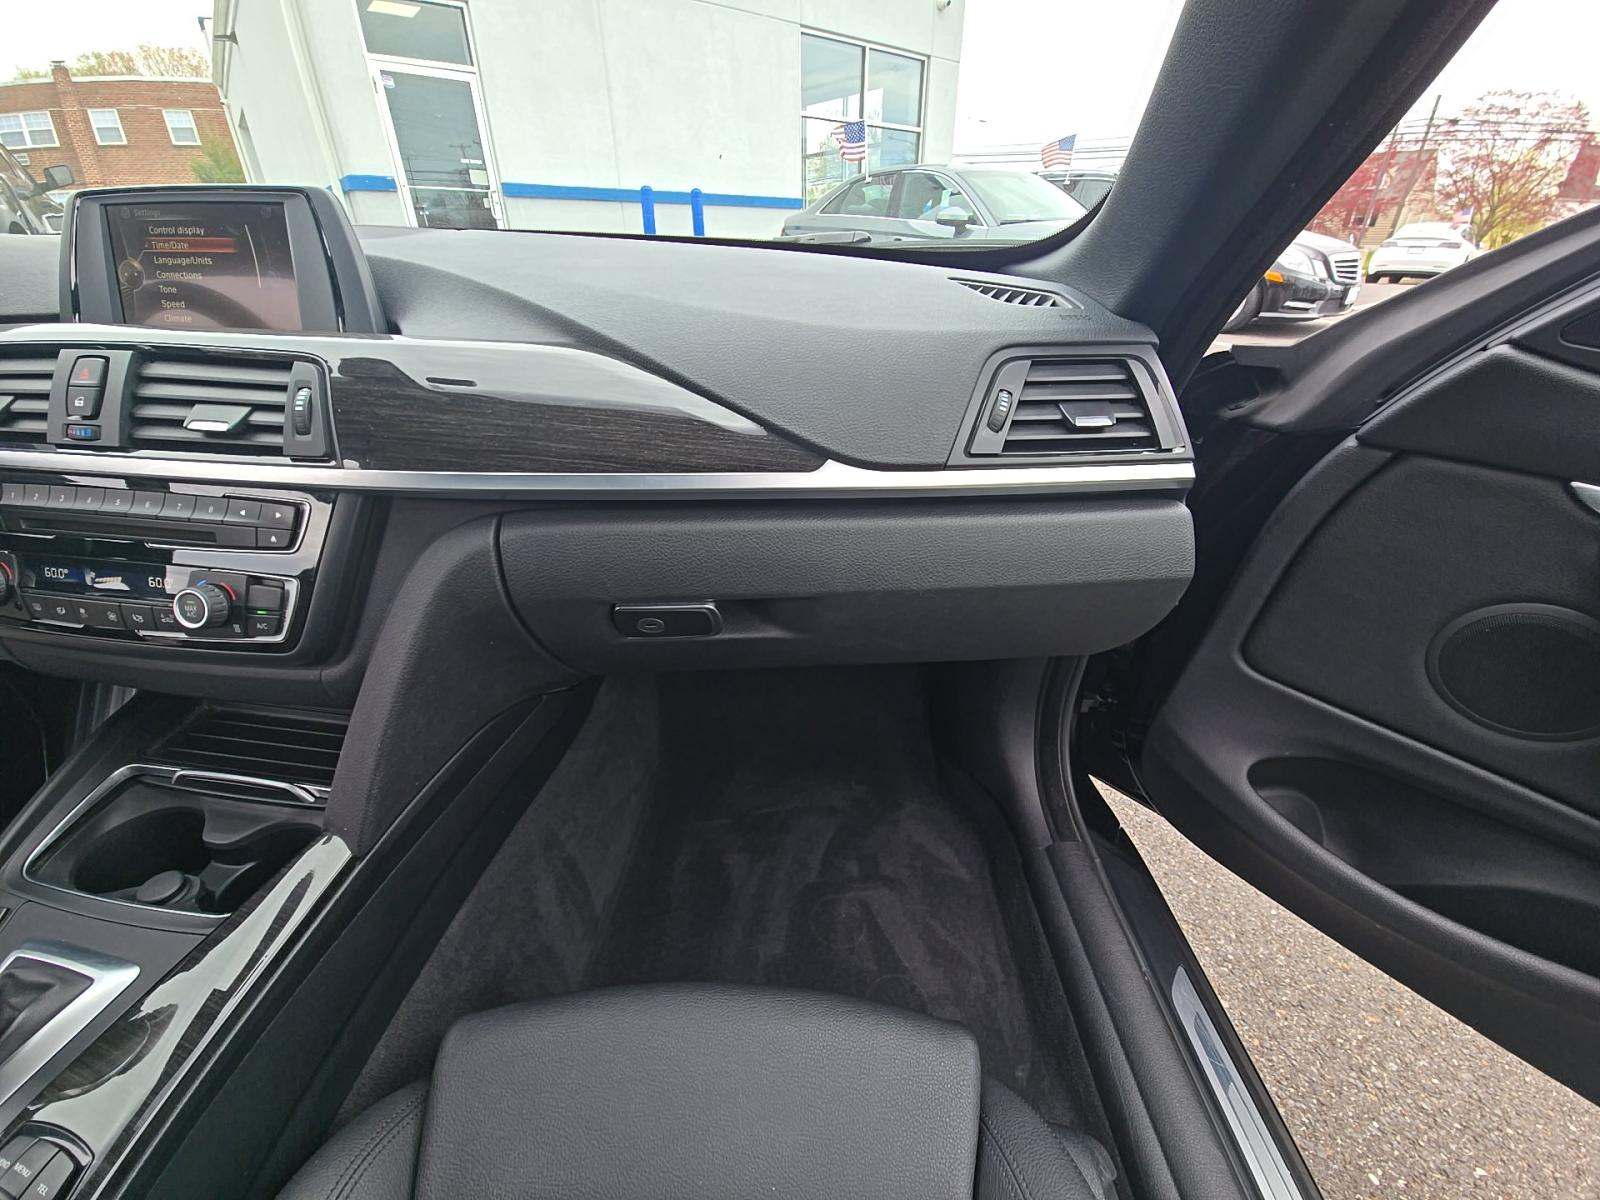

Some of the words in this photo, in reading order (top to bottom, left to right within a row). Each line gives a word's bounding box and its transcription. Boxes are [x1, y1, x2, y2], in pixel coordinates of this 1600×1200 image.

[148, 226, 175, 235] Control
[176, 225, 205, 236] display
[151, 241, 189, 250] Time/Date
[153, 256, 213, 266] Language/Units
[156, 270, 203, 280] Connections
[158, 284, 178, 294] Tone
[161, 299, 186, 309] Speed
[14, 1162, 31, 1178] MENU
[37, 1183, 49, 1197] TEL
